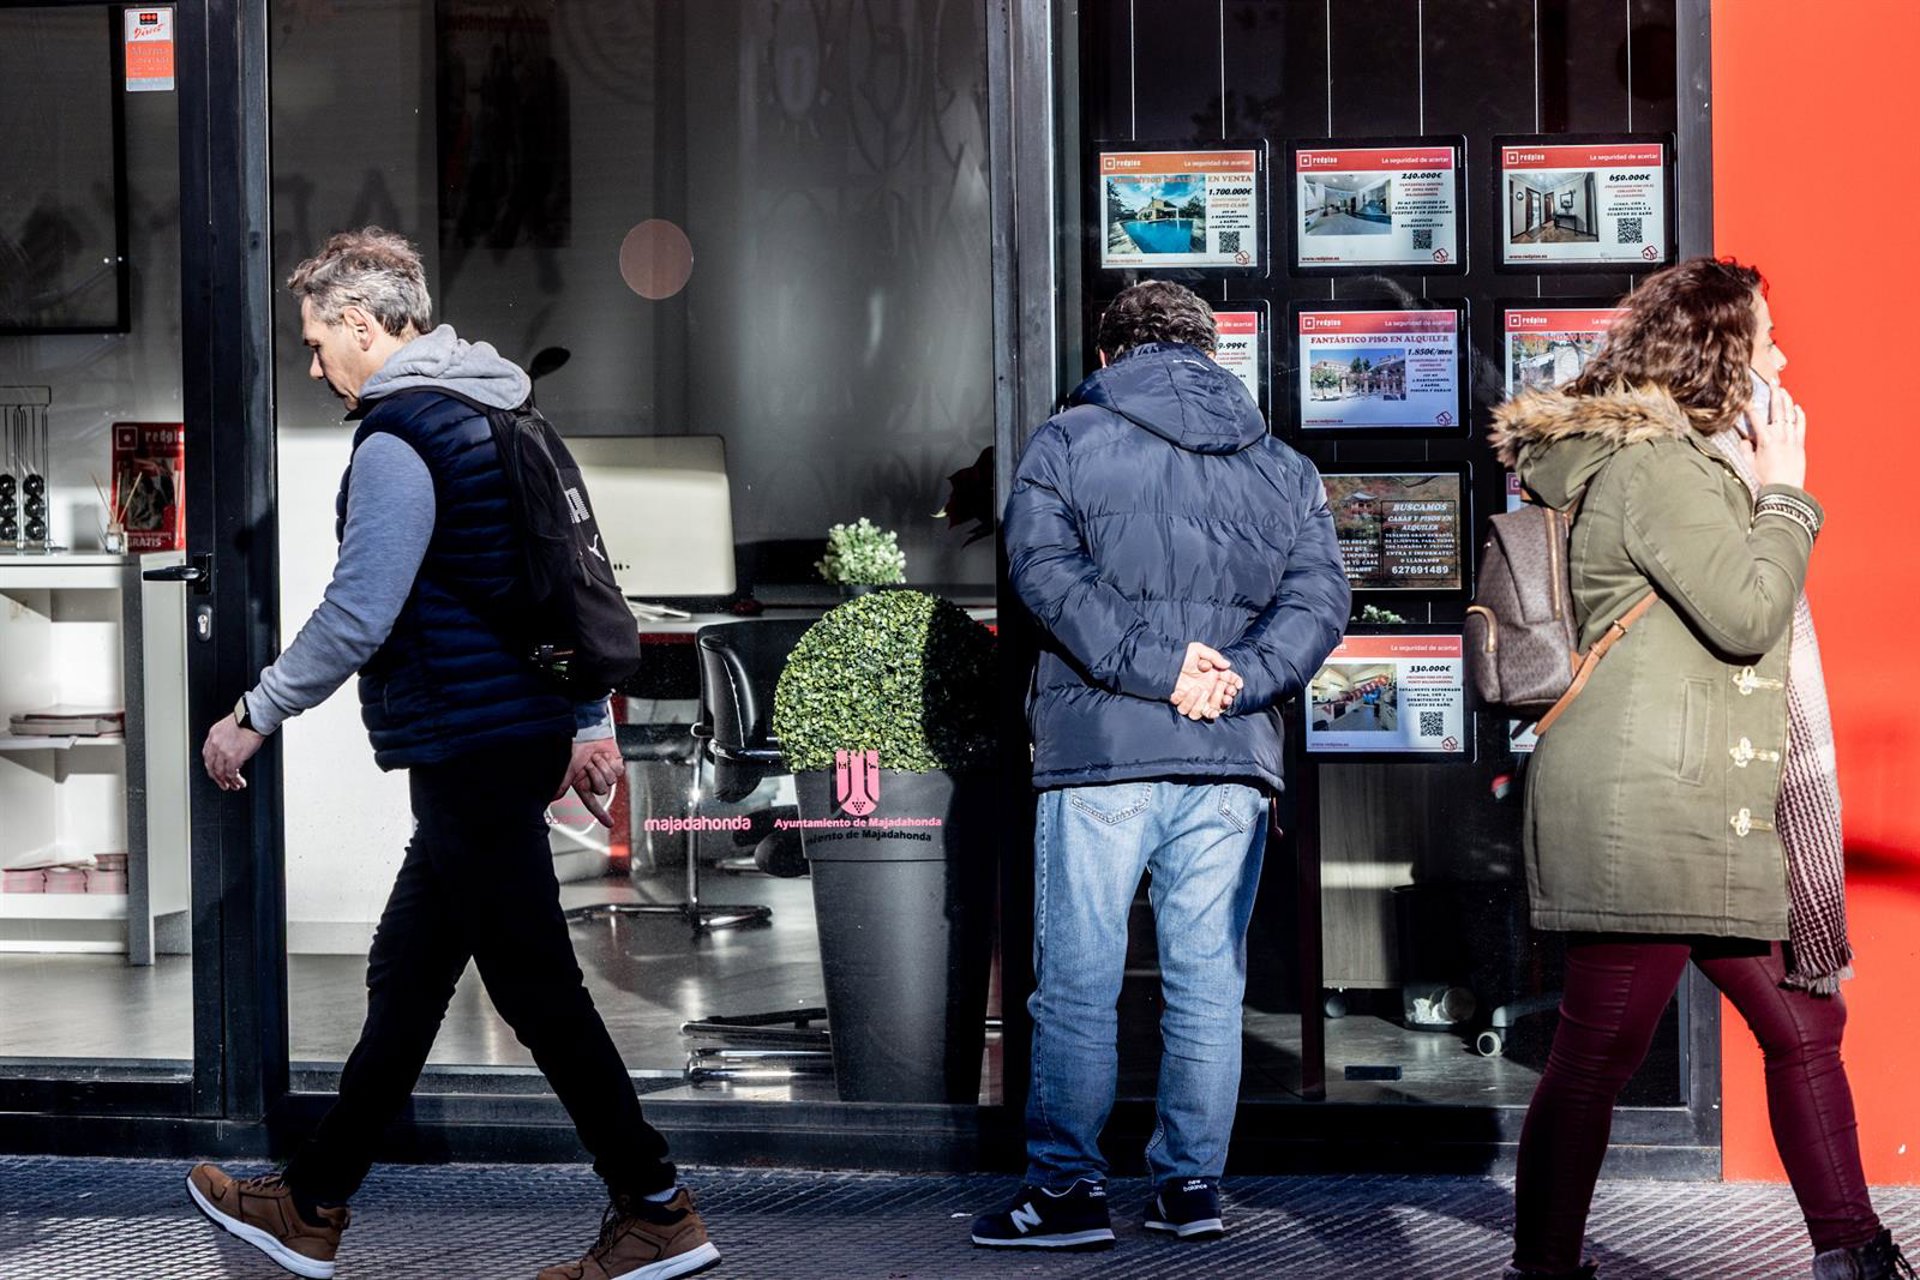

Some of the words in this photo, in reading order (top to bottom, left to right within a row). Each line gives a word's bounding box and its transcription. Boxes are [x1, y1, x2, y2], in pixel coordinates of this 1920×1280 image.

[1313, 156, 1338, 164] redpiso
[1598, 153, 1627, 162] seguridad
[1609, 173, 1651, 182] 650.000€
[1209, 187, 1253, 196] 1.700.000€
[1316, 319, 1341, 327] redpiso
[1310, 335, 1367, 344] FANTÁSTICO
[1368, 335, 1388, 343] PISO
[1390, 335, 1402, 343] EN
[1404, 335, 1449, 344] ALQUILER
[1392, 503, 1448, 512] BUSCAMOS
[1402, 524, 1439, 532] ALQUILER
[1391, 565, 1449, 575] 627691489
[1399, 644, 1428, 653] seguridad
[1409, 664, 1452, 673] 330.000€
[644, 815, 752, 835] majadahonda
[774, 817, 851, 831] Ayuntamiento
[853, 818, 866, 828] de
[868, 817, 942, 830] Majadahonda
[845, 829, 860, 840] de
[862, 829, 932, 842] Majadahonda
[1182, 1183, 1208, 1192] balance
[1010, 1201, 1043, 1234] N
